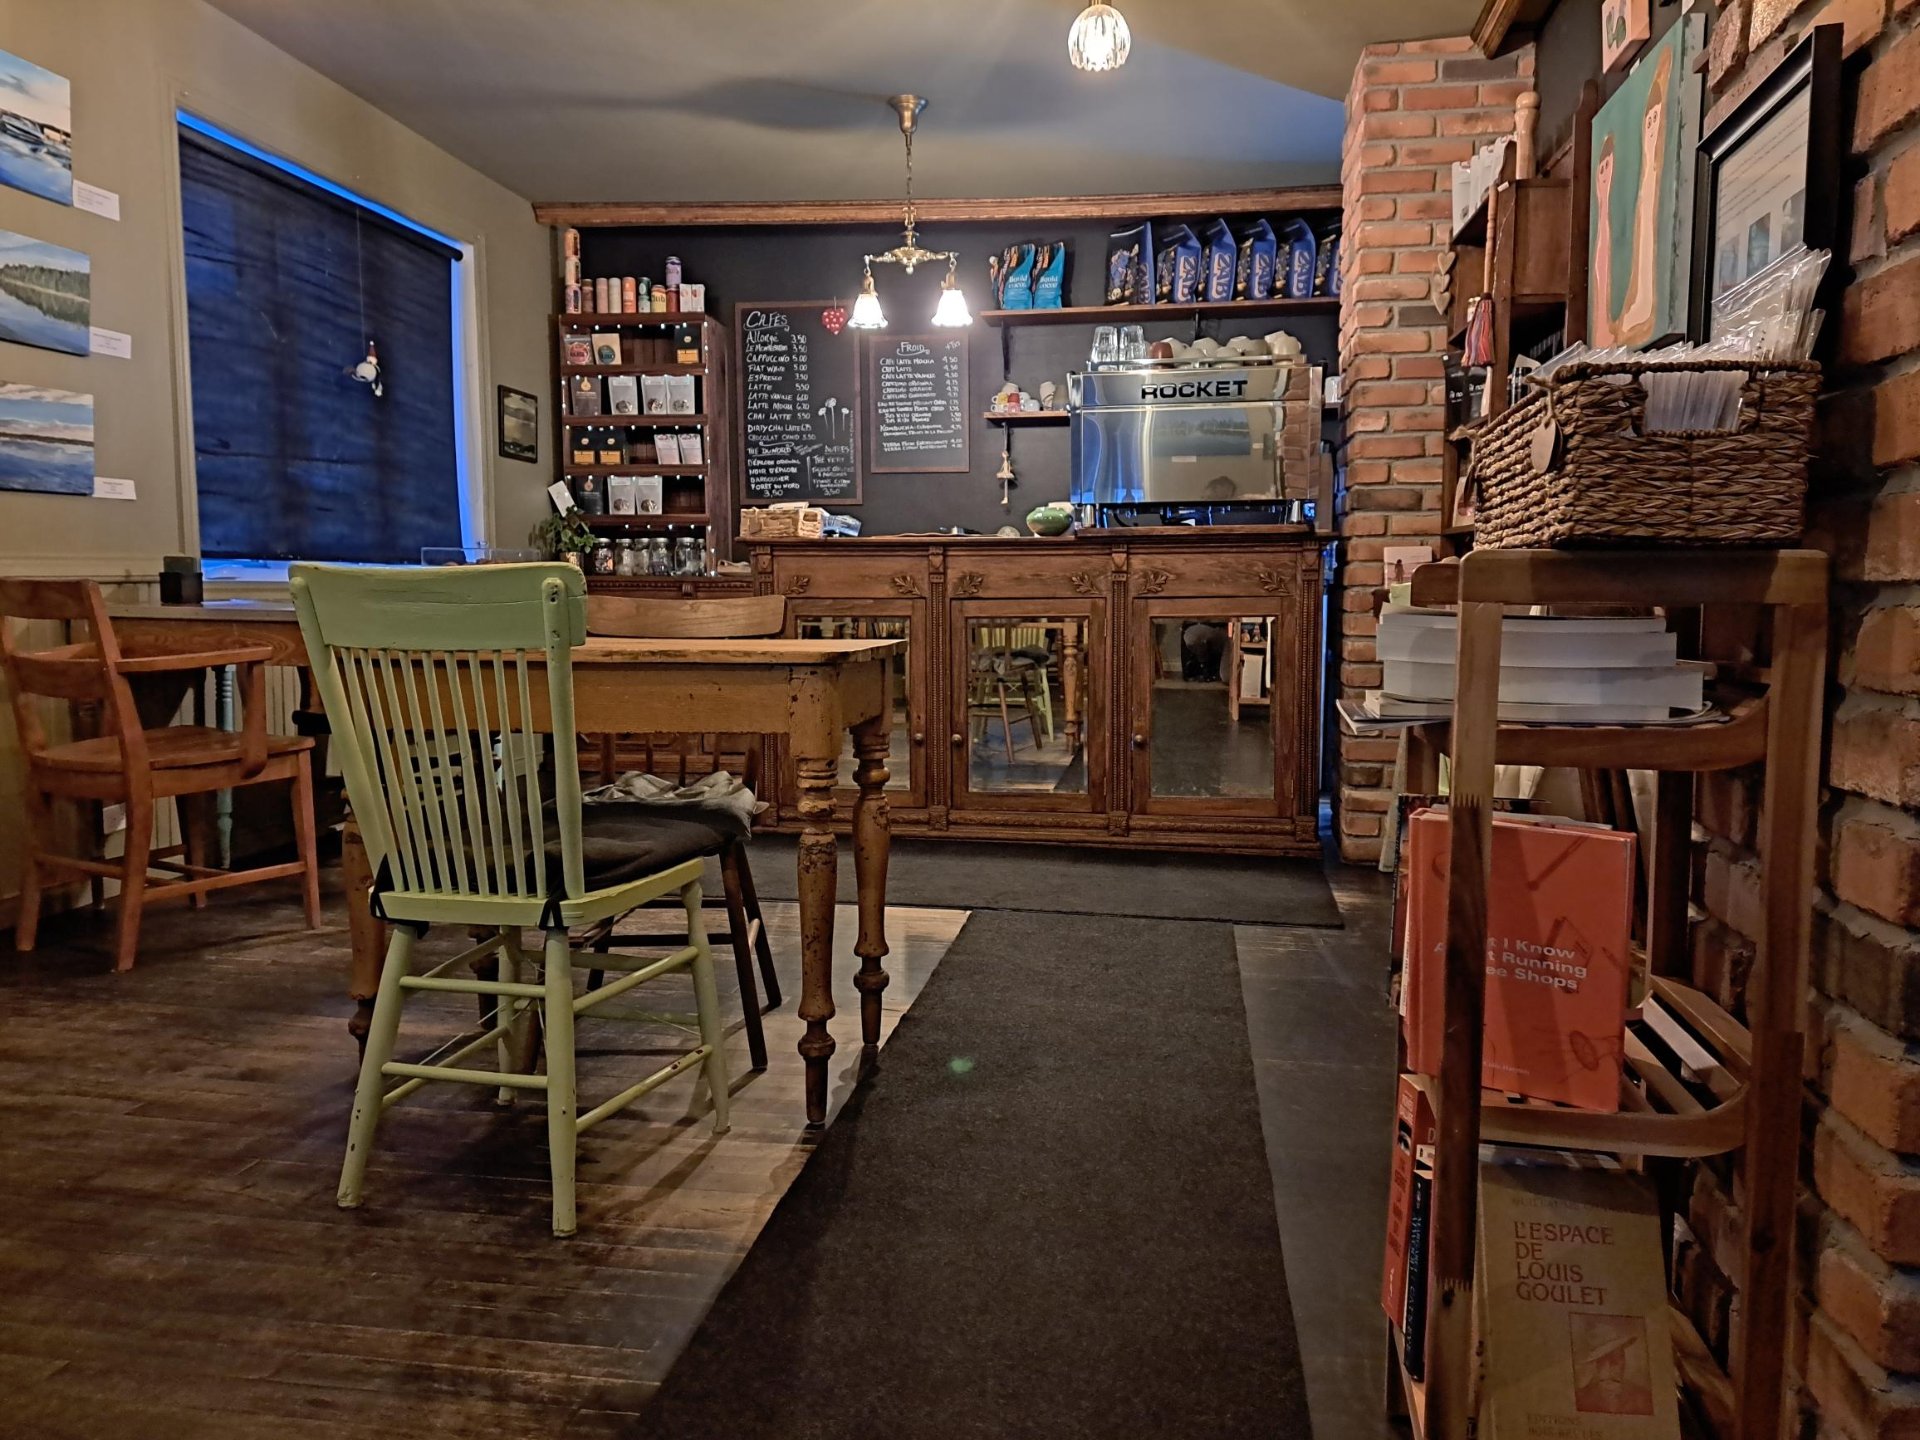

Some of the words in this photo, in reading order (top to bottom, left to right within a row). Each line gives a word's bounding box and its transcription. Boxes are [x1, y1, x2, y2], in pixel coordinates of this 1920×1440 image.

[1177, 255, 1198, 301] ZAB
[1212, 252, 1232, 300] ZAB
[901, 342, 924, 352] FROID
[748, 392, 769, 400] LATTE
[1141, 380, 1248, 399] ROCKET
[747, 424, 767, 433] DIRTY
[1503, 938, 1509, 949] I
[1515, 939, 1575, 959] Know
[1502, 952, 1587, 979] Running
[1514, 967, 1578, 990] Shops
[1514, 1221, 1614, 1246] L'ESPACE
[1515, 1241, 1544, 1260] DE
[1516, 1261, 1584, 1283] LOUIS
[1516, 1281, 1607, 1306] GOULET
